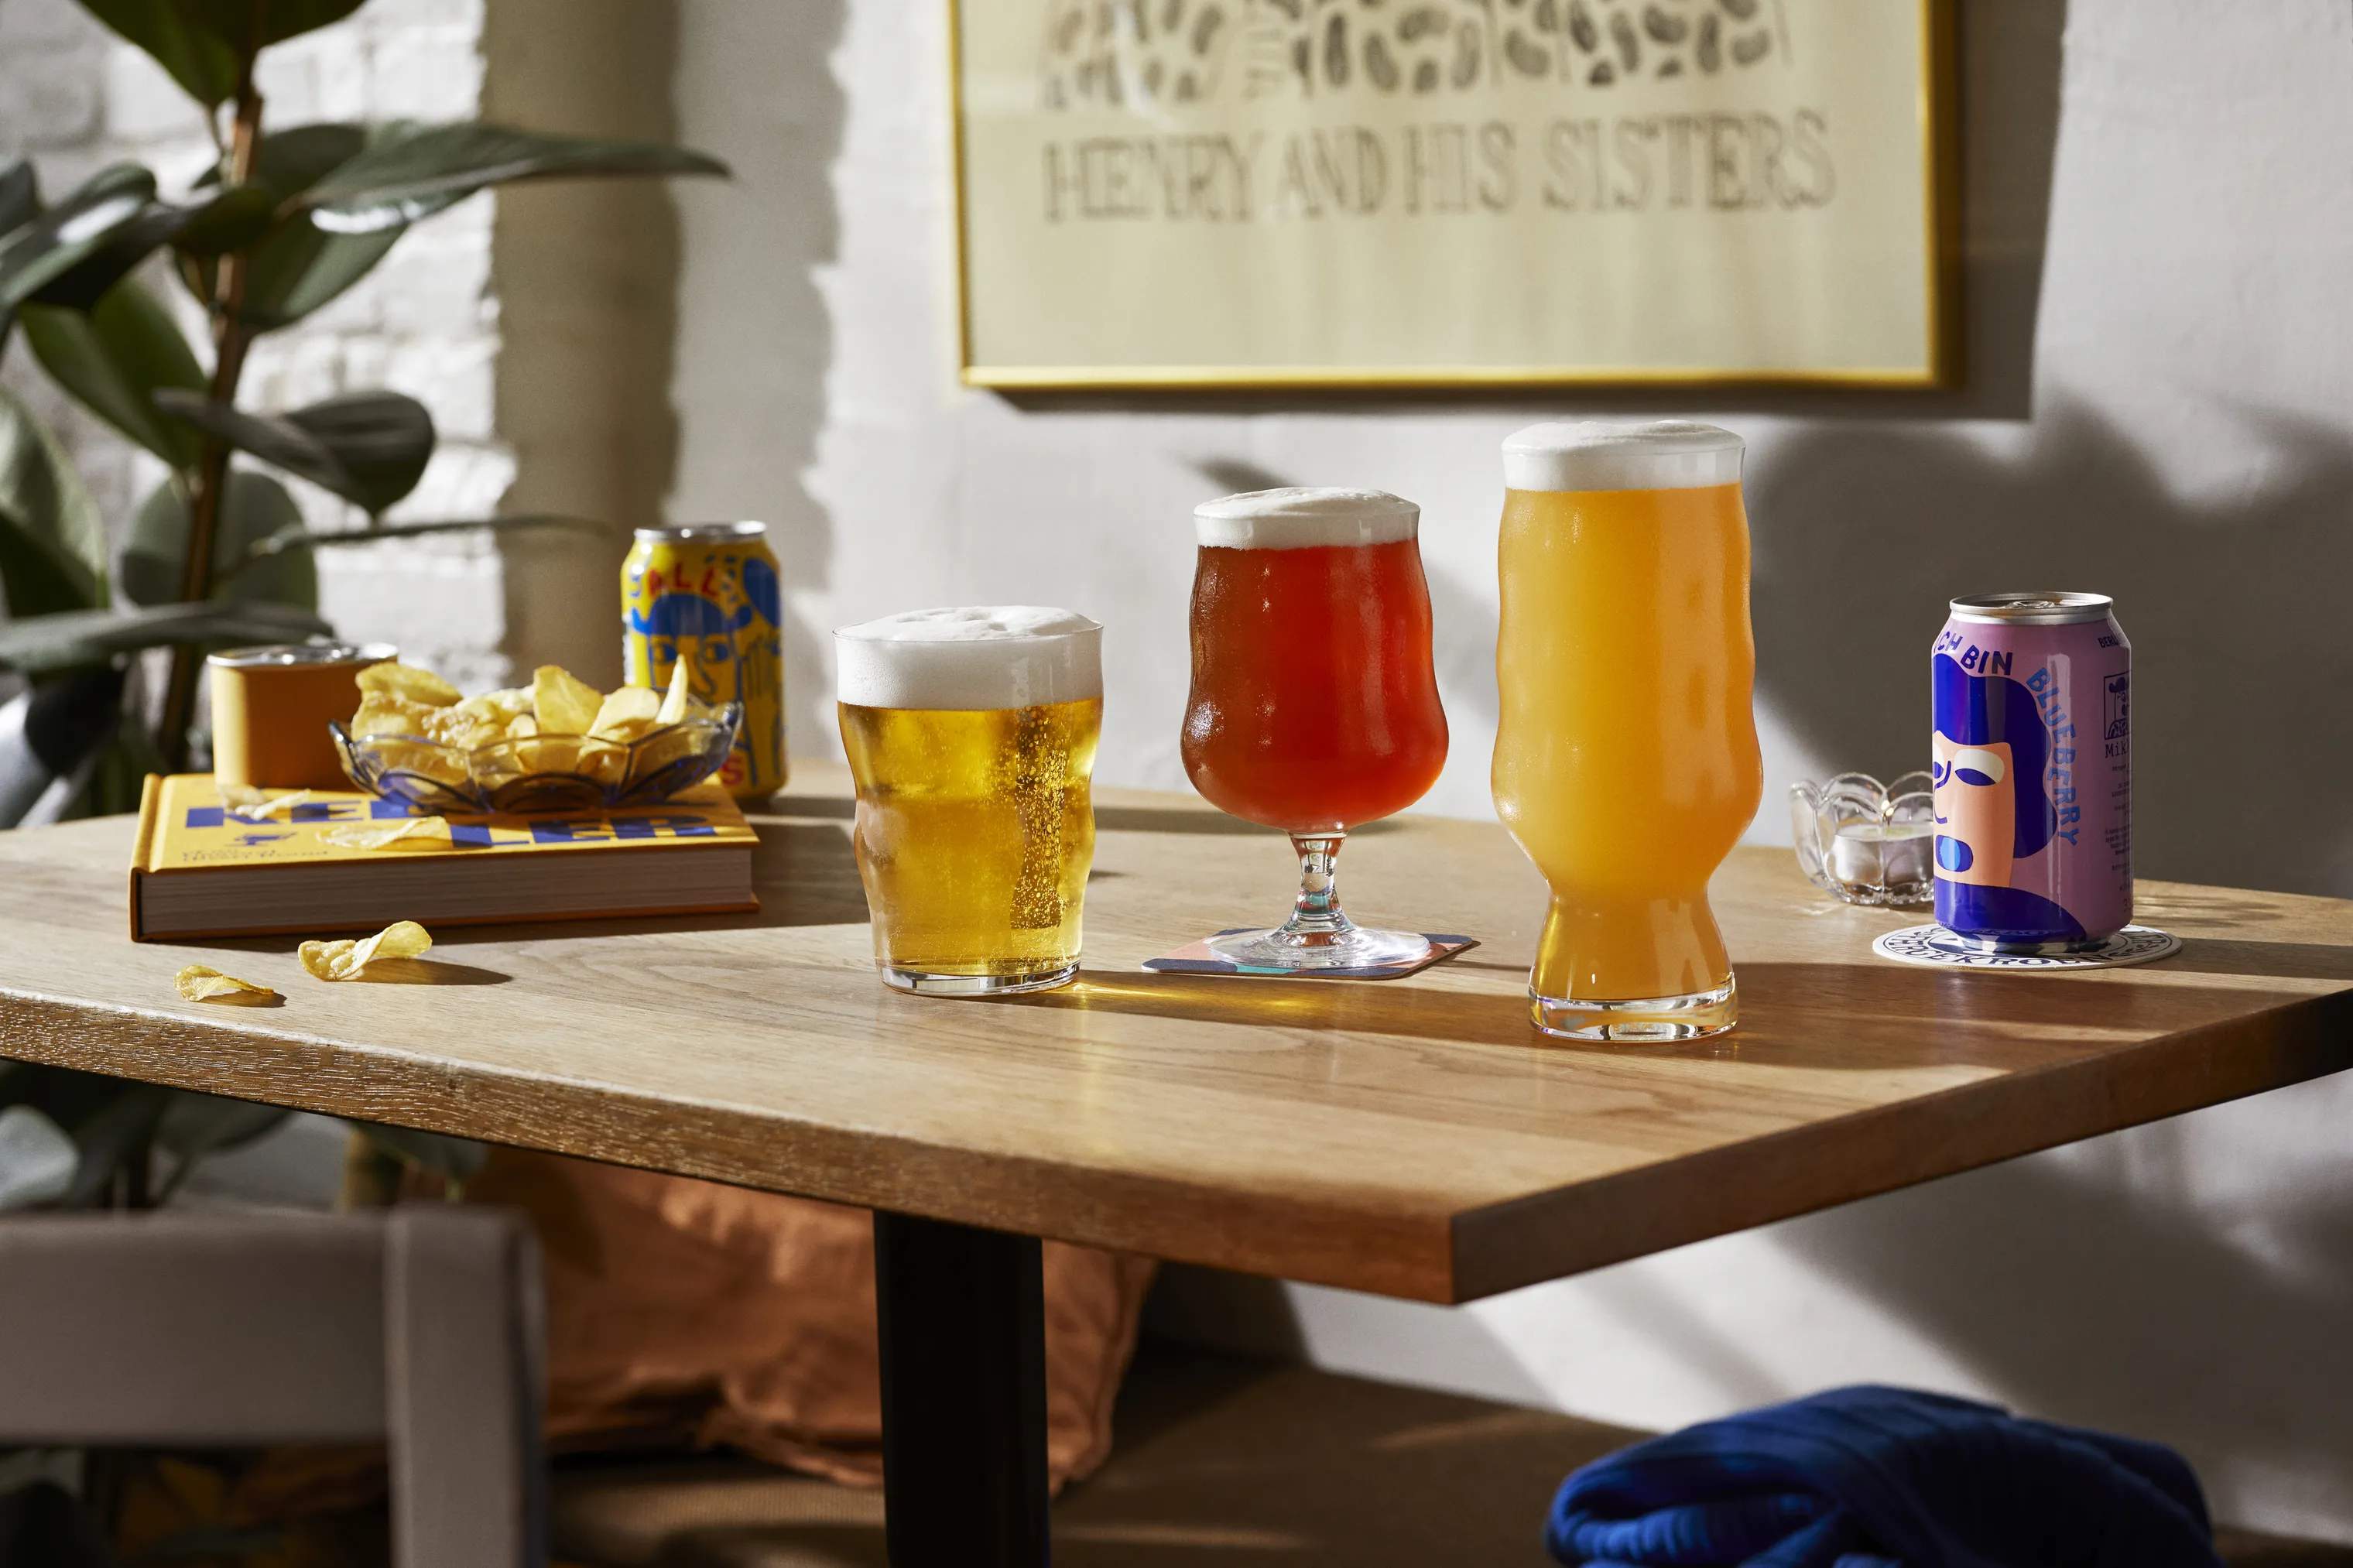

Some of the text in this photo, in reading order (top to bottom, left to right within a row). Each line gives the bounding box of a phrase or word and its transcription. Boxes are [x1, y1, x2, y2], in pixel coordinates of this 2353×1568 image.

[1039, 108, 1838, 224] HENRY AND HIS SISTERS
[1960, 644, 2013, 676] BIN
[2026, 667, 2081, 846] BLUEBERRY
